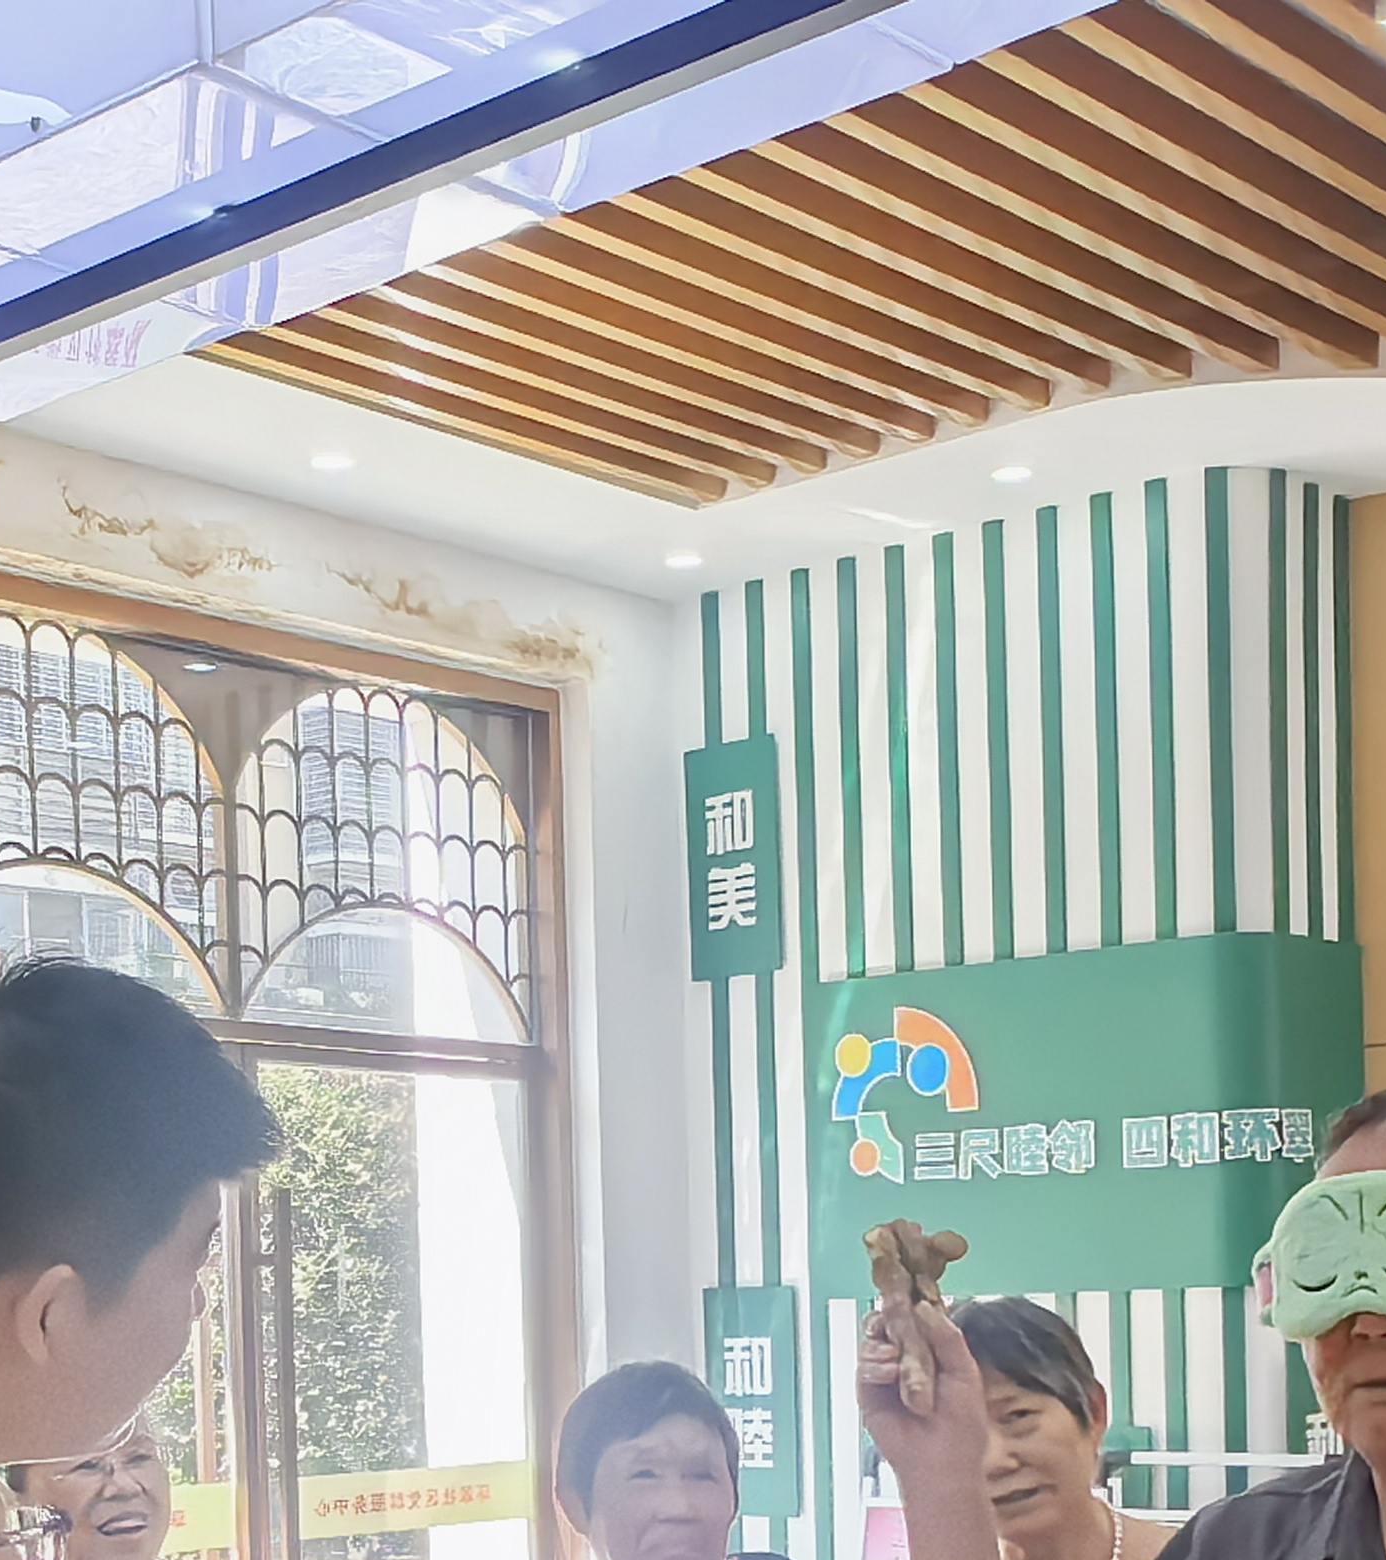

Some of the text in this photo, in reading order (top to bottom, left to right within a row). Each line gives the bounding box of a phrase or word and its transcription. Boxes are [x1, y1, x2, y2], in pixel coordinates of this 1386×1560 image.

[704, 789, 757, 931] 和美
[914, 1119, 1096, 1180] 三尺睦邻
[723, 1335, 775, 1471] 和睦
